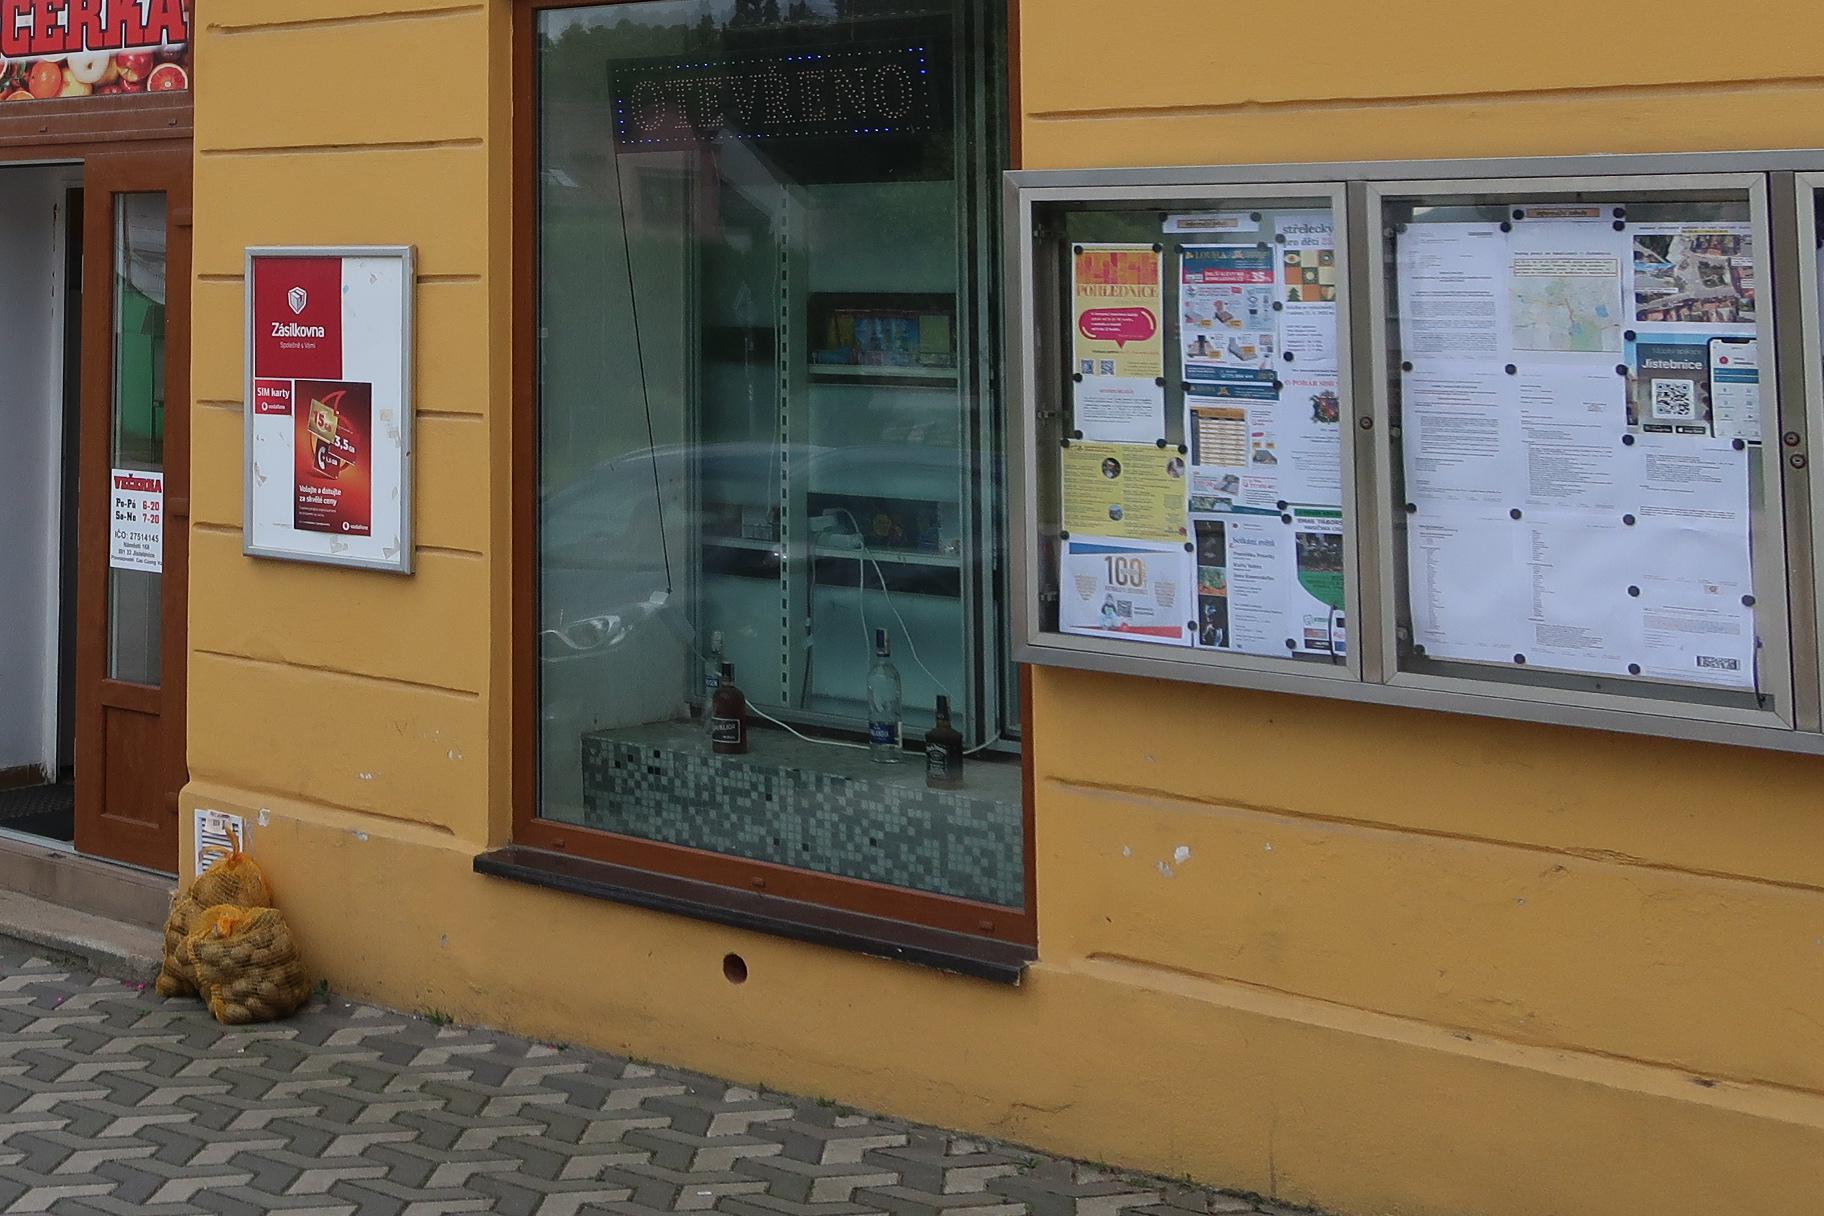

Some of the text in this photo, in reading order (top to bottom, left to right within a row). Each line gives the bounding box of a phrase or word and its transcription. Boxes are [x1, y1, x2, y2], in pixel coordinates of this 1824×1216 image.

[631, 61, 913, 132] OTEVŘENO
[271, 322, 325, 337] Zásilkovna
[1642, 358, 1703, 370] Jistebnice
[257, 388, 290, 399] SIM karty
[116, 498, 136, 509] Po-Pá
[142, 513, 159, 524] 7-20
[130, 532, 159, 543] 27514145
